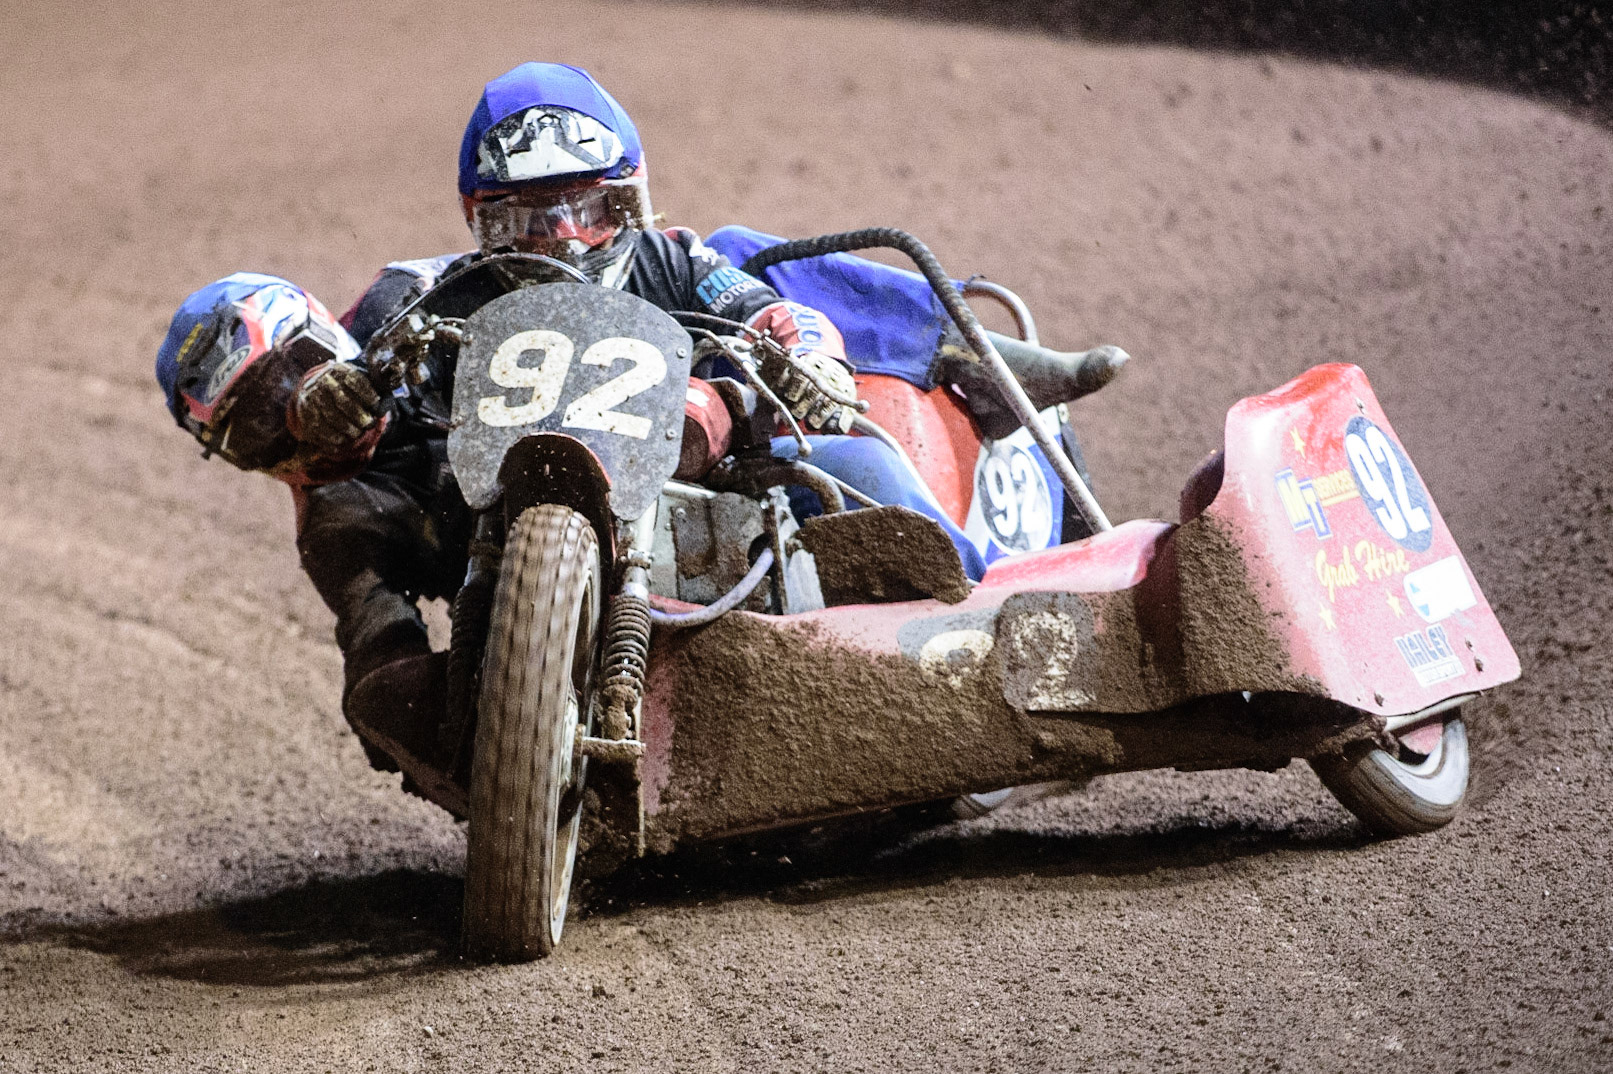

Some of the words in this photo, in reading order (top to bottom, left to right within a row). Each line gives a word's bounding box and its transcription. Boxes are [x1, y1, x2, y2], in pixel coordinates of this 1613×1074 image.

[477, 329, 668, 440] 92
[985, 452, 1046, 536] 92
[1345, 425, 1431, 540] 92
[1315, 549, 1360, 603] Grab
[1354, 540, 1411, 582] Hire
